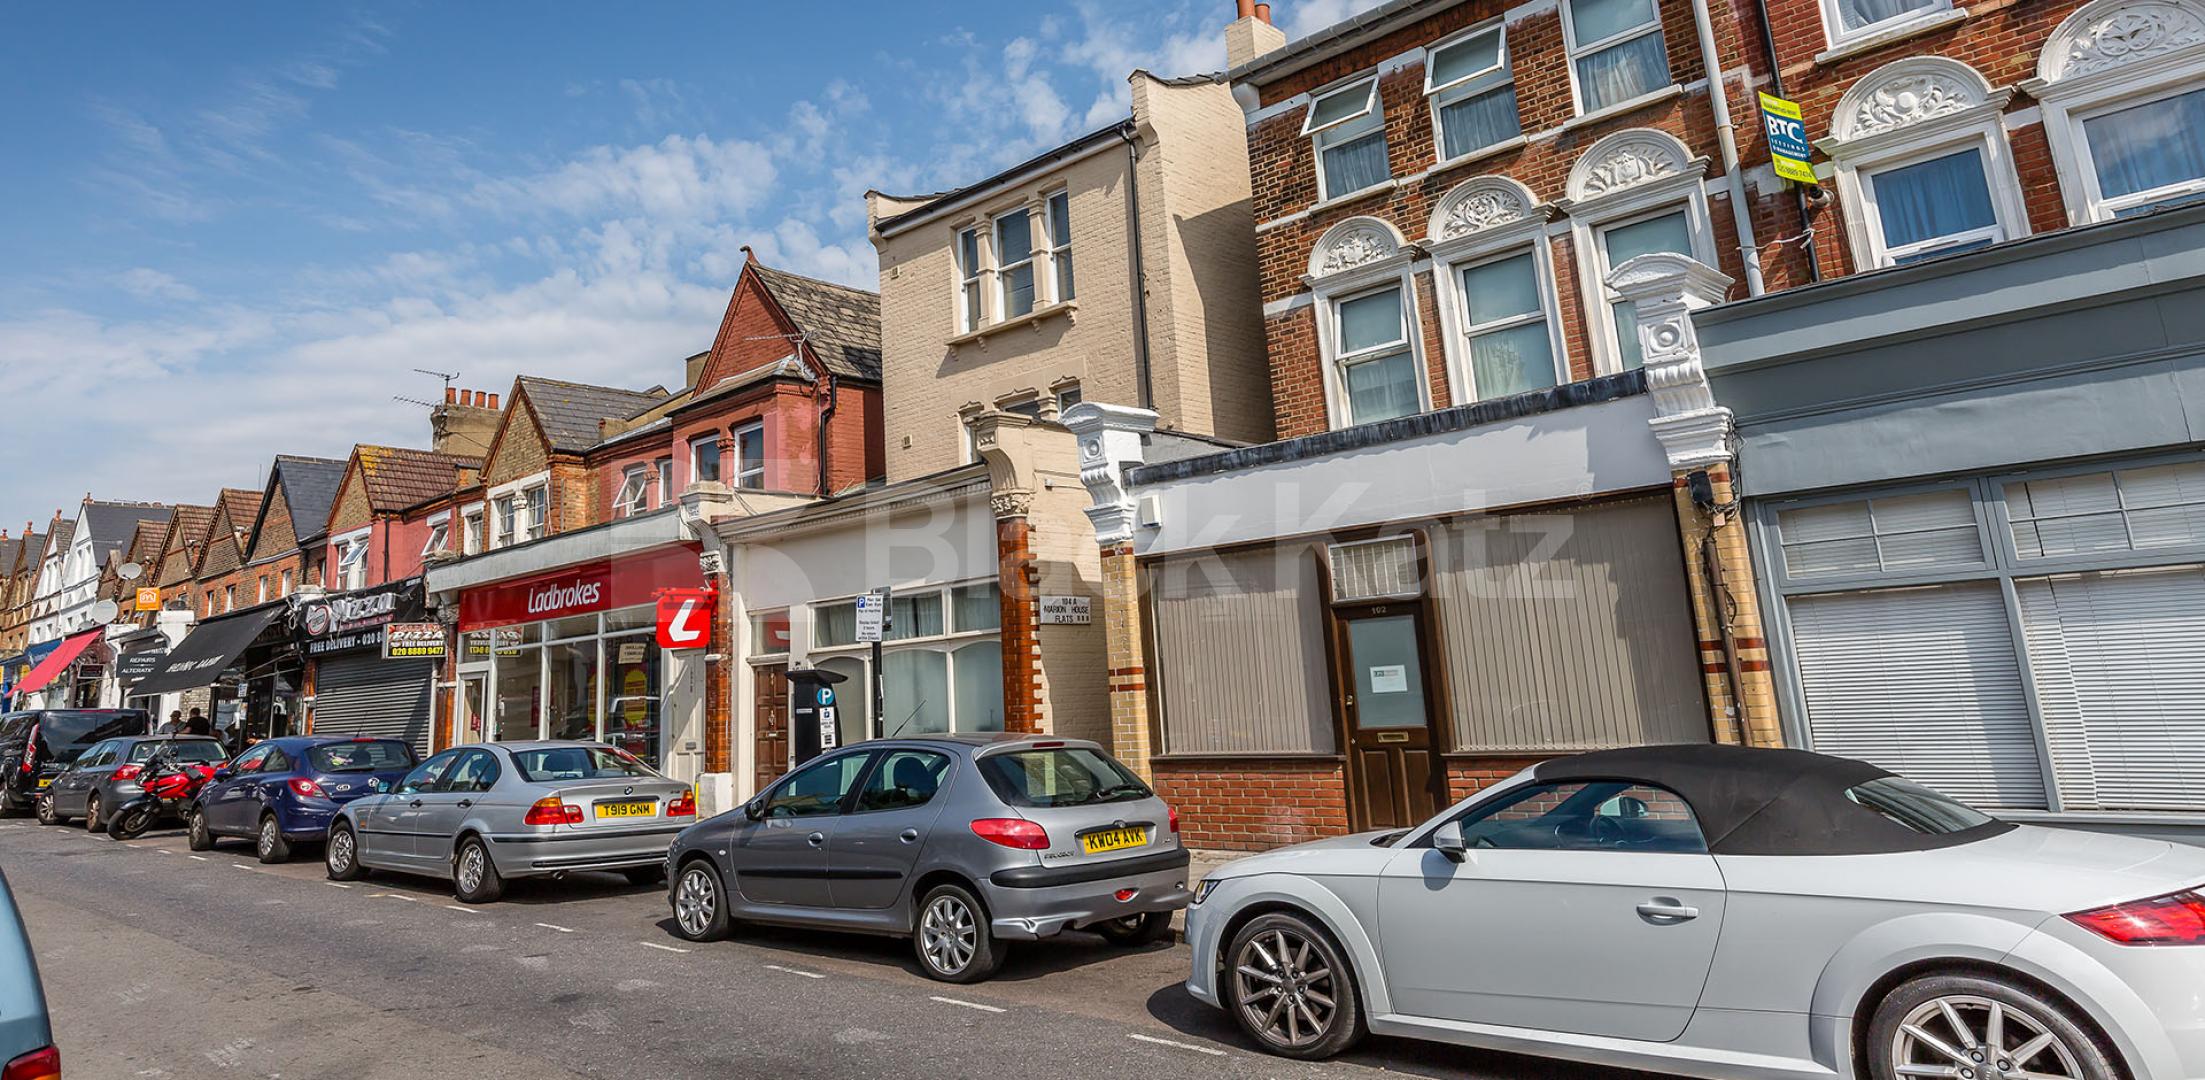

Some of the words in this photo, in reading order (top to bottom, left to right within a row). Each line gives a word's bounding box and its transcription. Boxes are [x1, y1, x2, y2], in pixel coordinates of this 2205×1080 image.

[1766, 114, 1803, 144] BTC
[528, 579, 600, 613] Ladbrokes
[1043, 605, 1067, 614] MARION
[1071, 606, 1089, 614] HOUSE
[1372, 606, 1386, 614] 102
[392, 631, 444, 640] PIZZA
[310, 641, 325, 653] FREE
[326, 636, 356, 651] DELIVERY
[362, 633, 375, 646] 020
[392, 648, 407, 656] 020
[822, 688, 832, 704] P
[603, 805, 627, 816] T919
[630, 804, 650, 814] GNM
[1088, 832, 1121, 850] KW04
